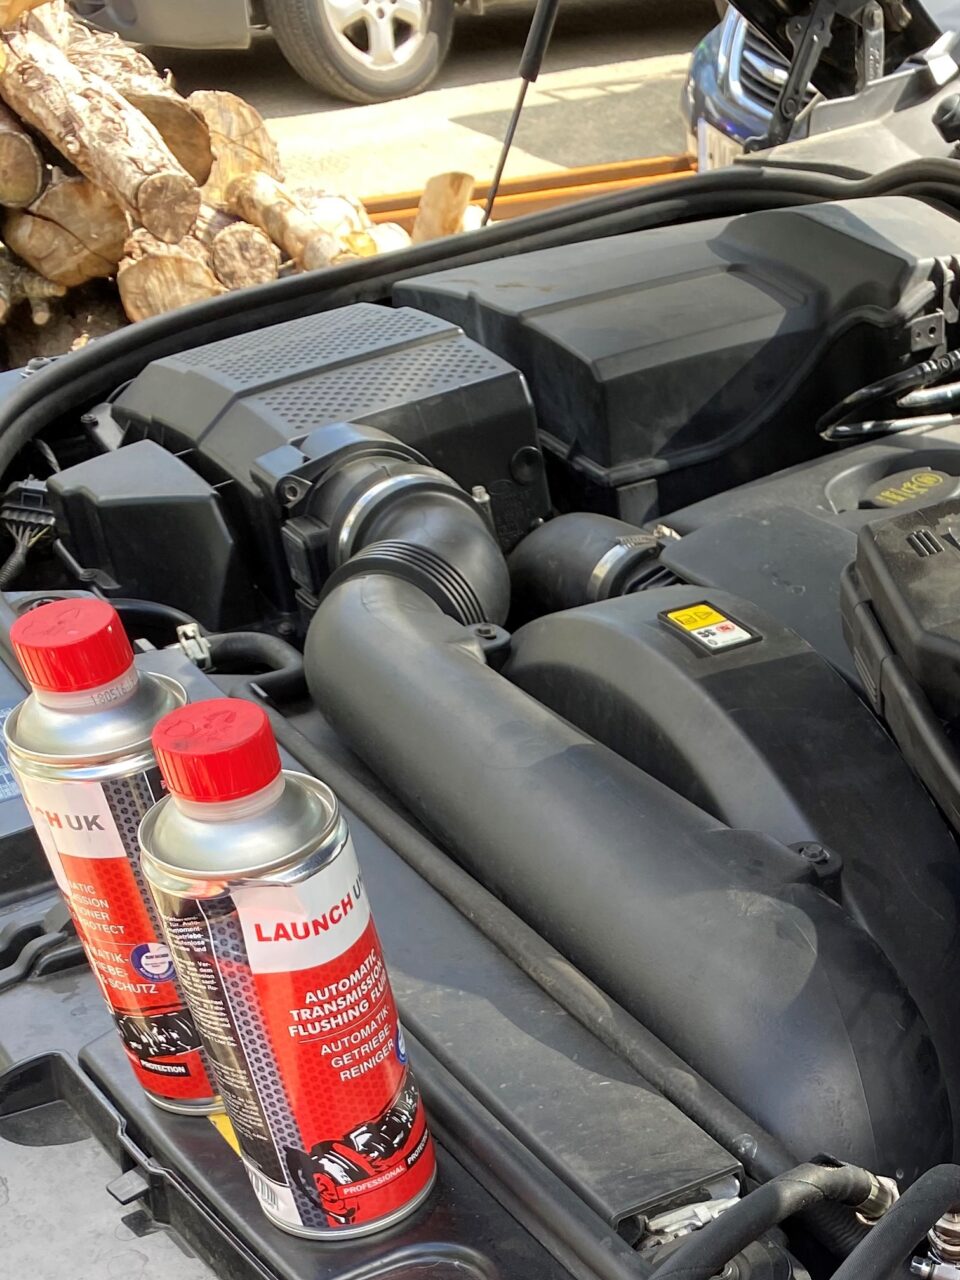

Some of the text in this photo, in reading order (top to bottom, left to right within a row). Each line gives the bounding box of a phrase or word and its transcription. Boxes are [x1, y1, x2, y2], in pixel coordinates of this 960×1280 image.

[65, 813, 105, 831] UK
[254, 892, 354, 942] LAUNCH
[289, 959, 383, 1022] TRANSMISSION
[305, 948, 377, 1005] AUTOMATIC
[288, 1000, 370, 1038] FLUSHING
[340, 1038, 394, 1082] REINIGER
[343, 1164, 406, 1195] PROFESSIONAL
